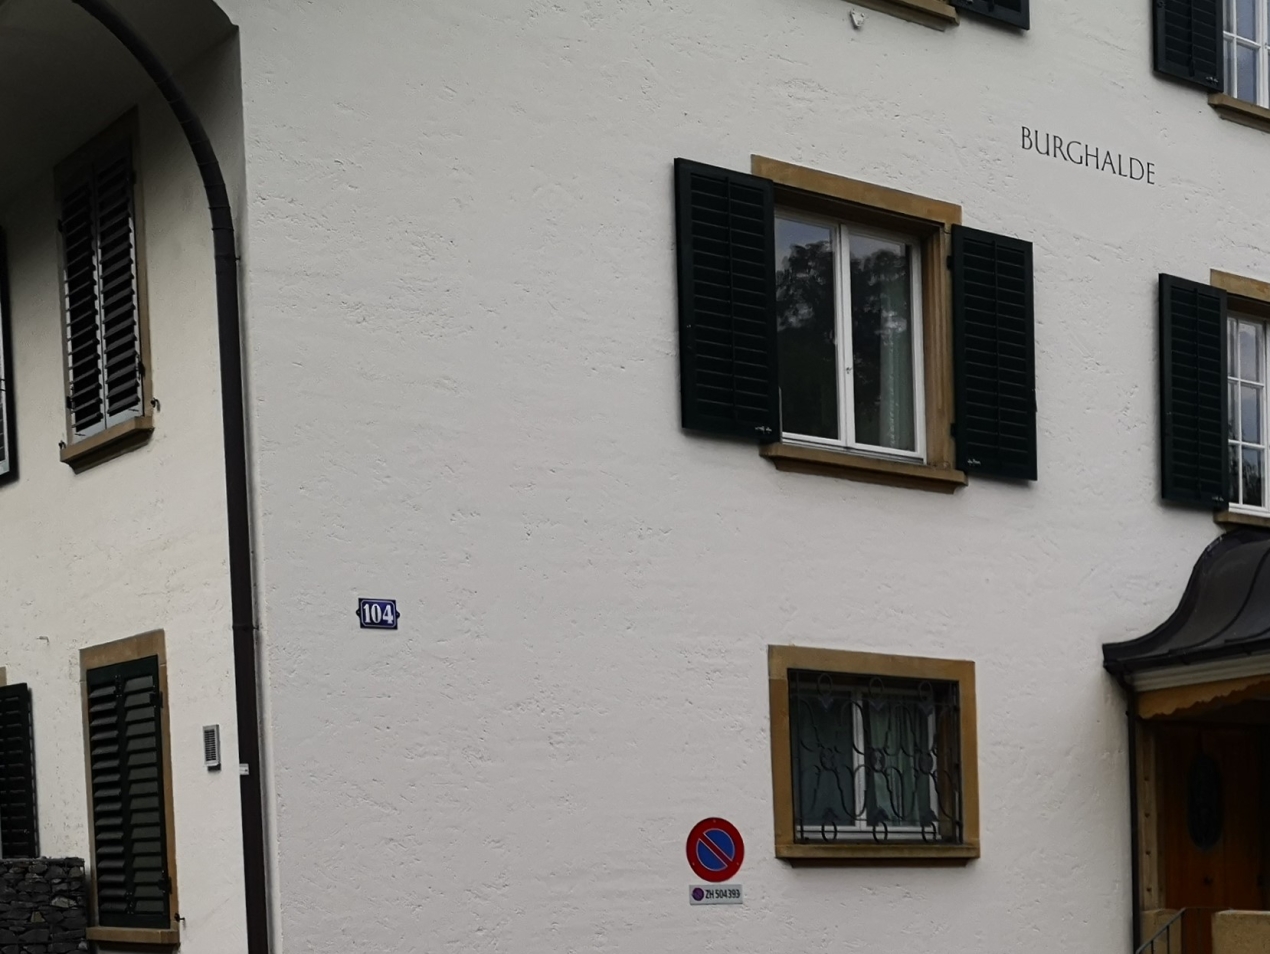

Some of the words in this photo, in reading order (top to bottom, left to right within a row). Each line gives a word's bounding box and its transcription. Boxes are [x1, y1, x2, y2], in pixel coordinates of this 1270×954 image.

[1021, 126, 1155, 185] BURGHALDE
[363, 603, 394, 624] 104
[705, 889, 714, 899] ZH
